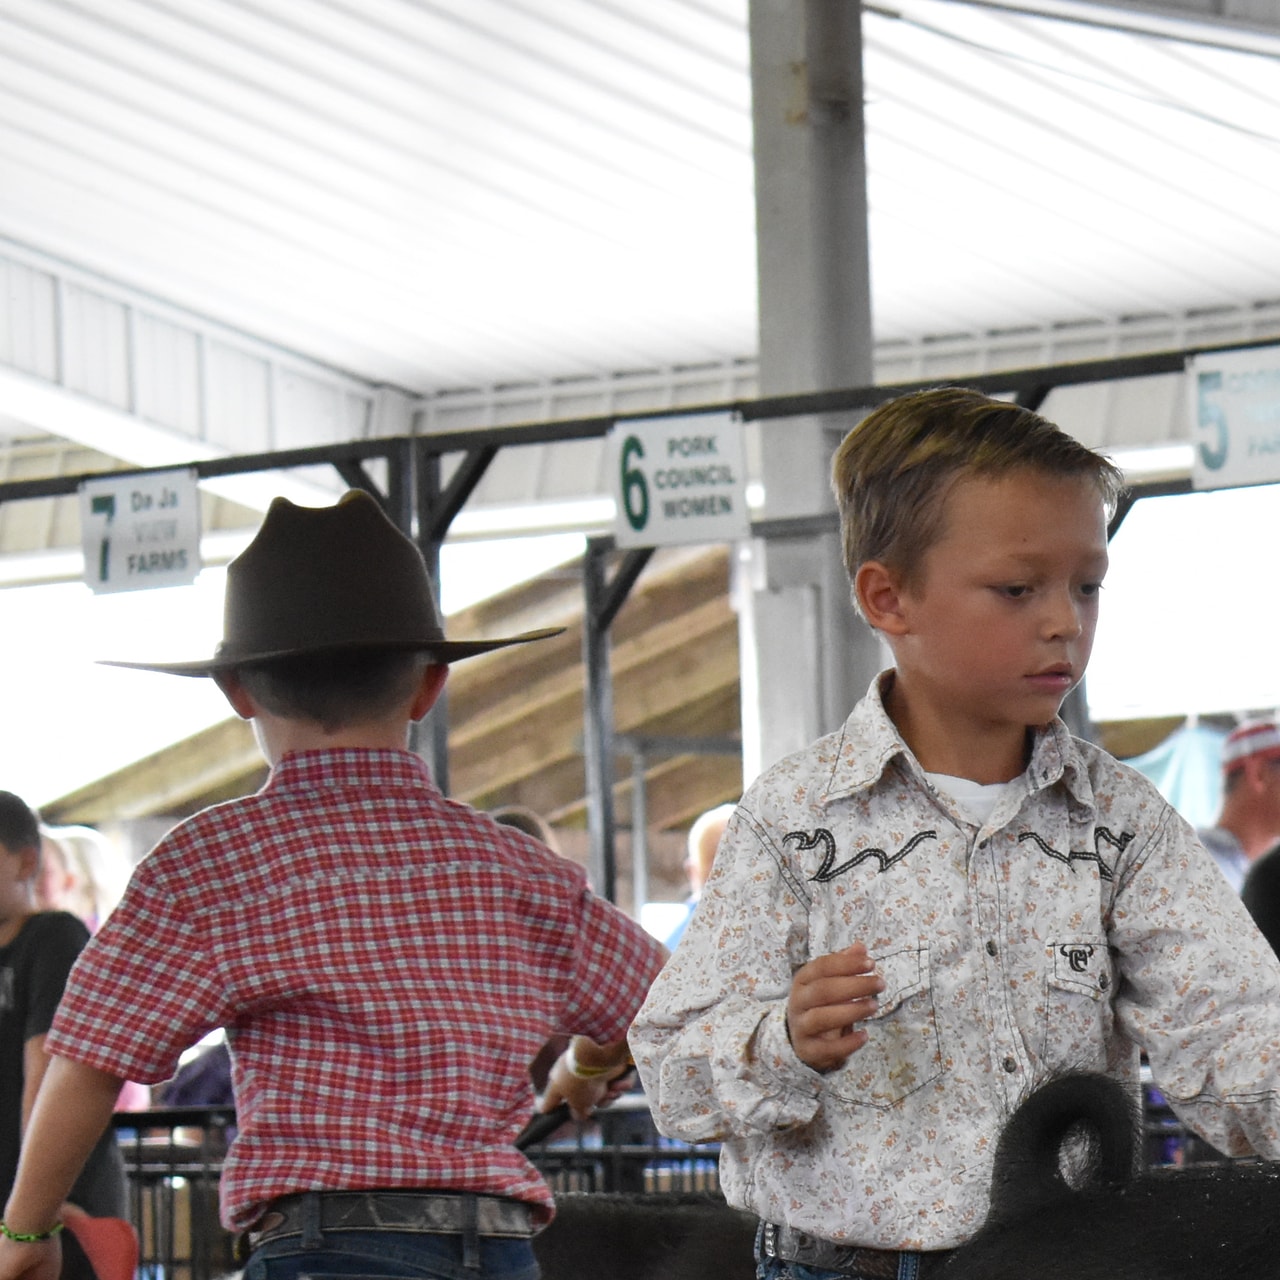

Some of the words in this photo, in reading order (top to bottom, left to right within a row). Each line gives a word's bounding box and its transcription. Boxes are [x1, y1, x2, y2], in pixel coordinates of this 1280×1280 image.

[1198, 370, 1229, 472] 5
[667, 435, 719, 458] PORK
[620, 435, 650, 533] 6
[654, 465, 736, 489] COUNCIL
[663, 495, 733, 519] WOMEN
[91, 493, 115, 583] 7
[127, 549, 188, 574] FARMS
